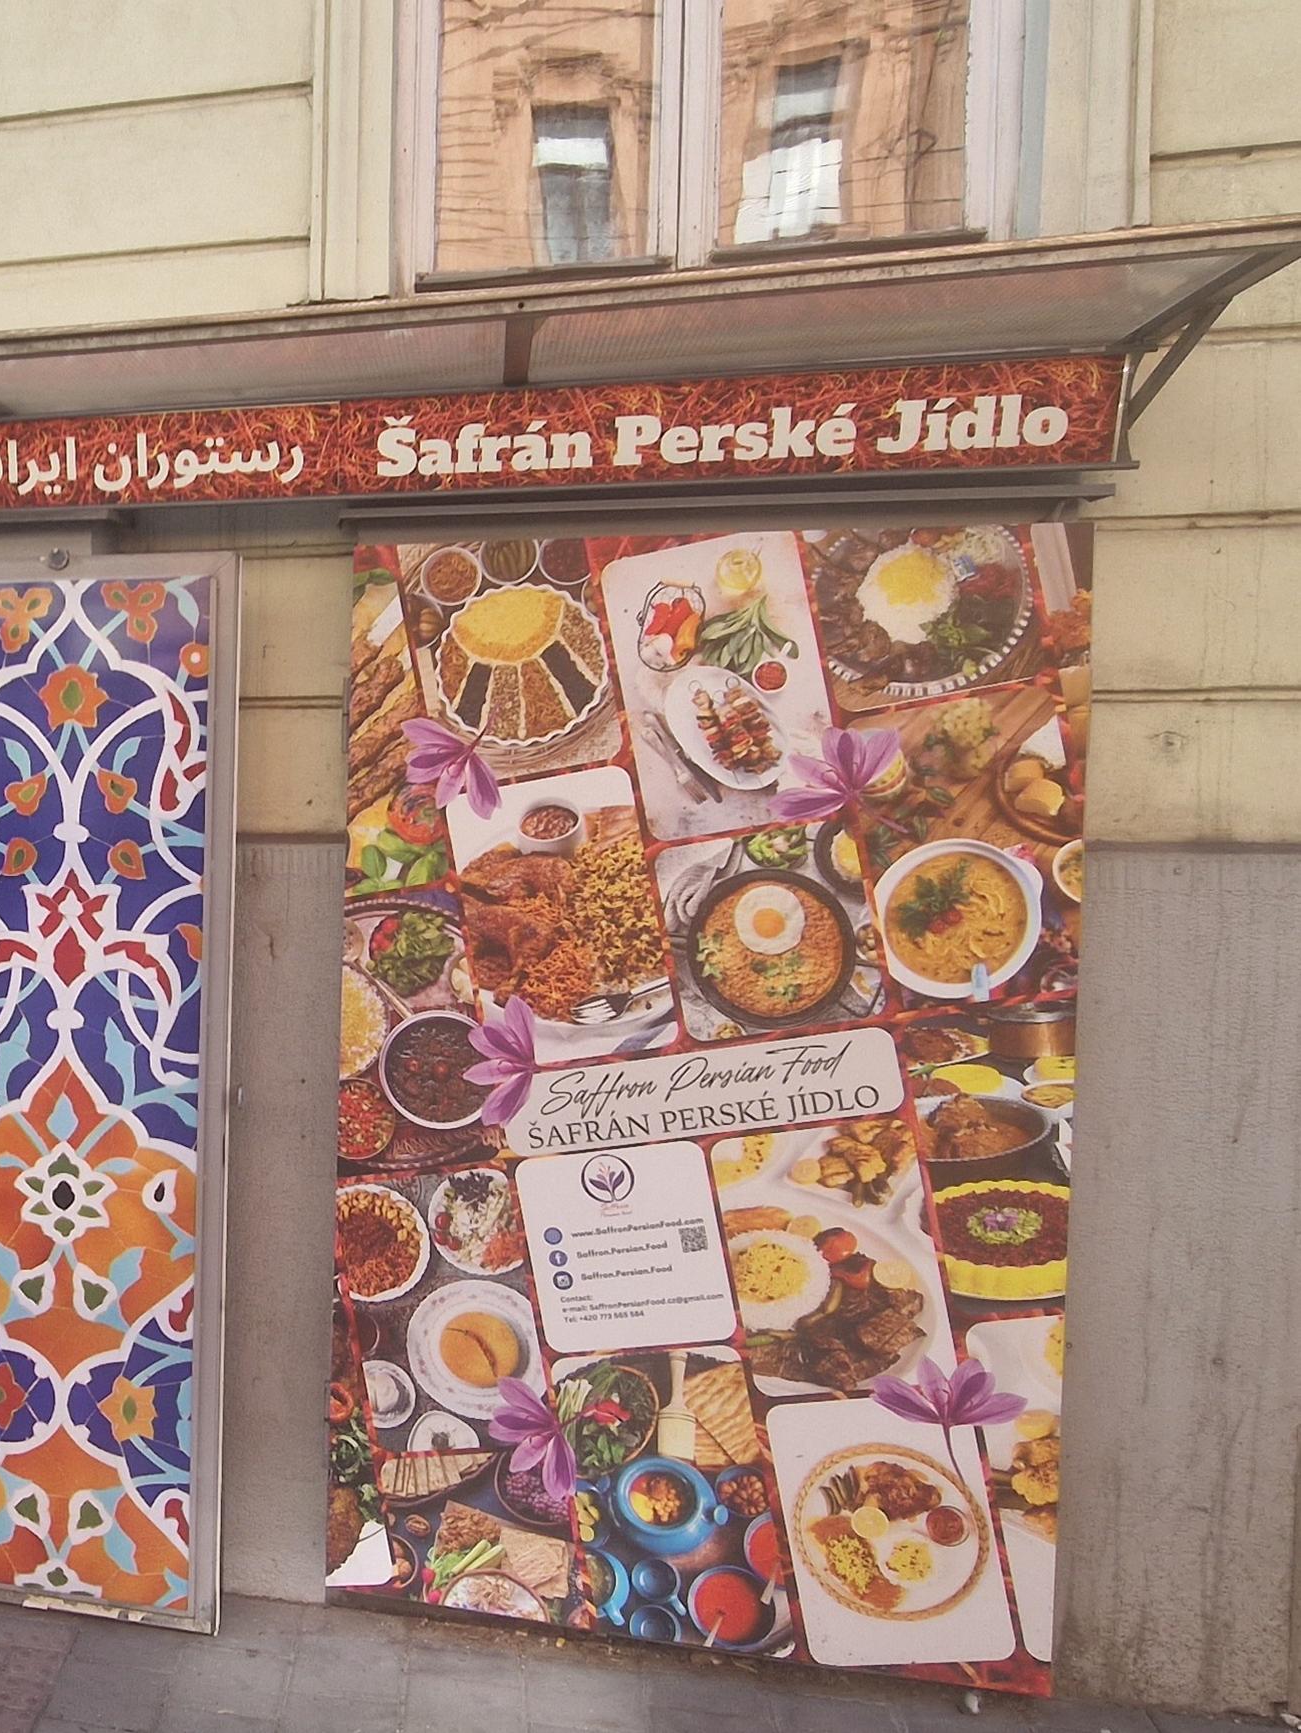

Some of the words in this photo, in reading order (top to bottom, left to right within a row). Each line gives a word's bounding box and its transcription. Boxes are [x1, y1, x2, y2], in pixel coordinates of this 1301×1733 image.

[93, 433, 305, 491] رستوران
[376, 416, 593, 478] Šafrán
[614, 403, 857, 466] Perské
[876, 394, 1069, 454] Jídlo
[540, 1071, 658, 1119] Saffron
[664, 1056, 778, 1103] Persian
[765, 1040, 853, 1085] Food
[527, 1111, 651, 1150] ŠAFRÁN
[660, 1090, 779, 1133] PERSKÉ
[785, 1084, 881, 1123] JÍDLO
[570, 1216, 705, 1239] www.SaffronPersianFood.com
